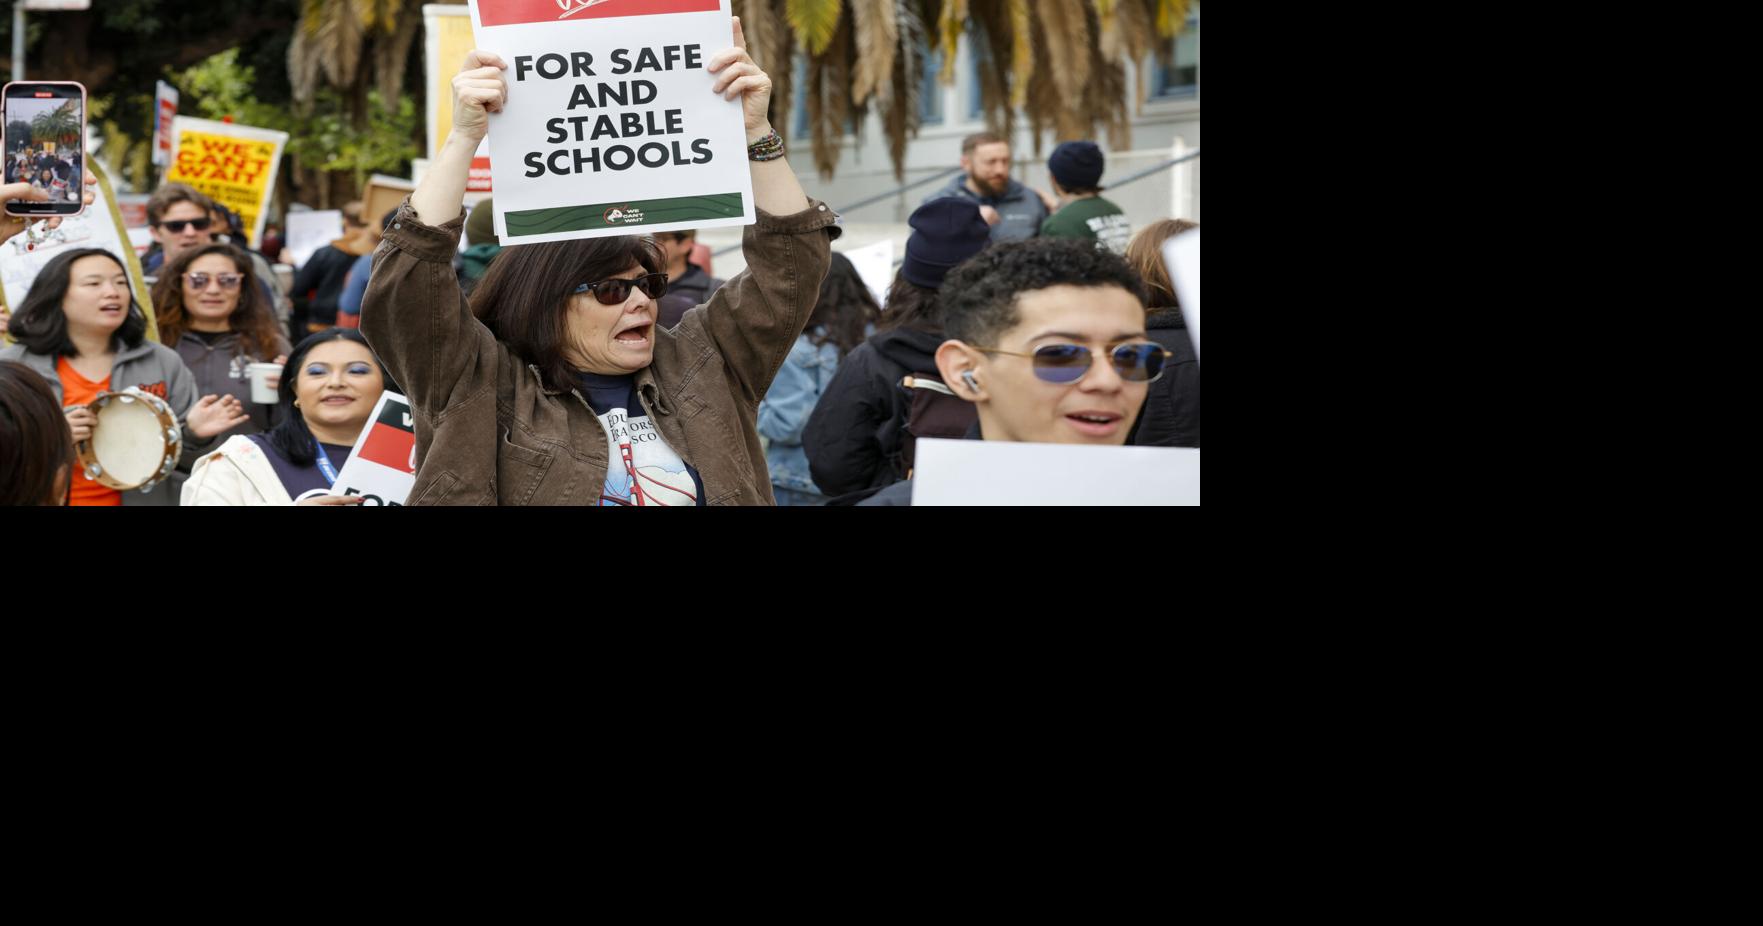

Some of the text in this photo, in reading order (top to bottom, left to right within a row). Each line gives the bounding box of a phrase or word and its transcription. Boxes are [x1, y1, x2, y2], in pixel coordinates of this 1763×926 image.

[514, 43, 703, 82] FOR SAFE
[566, 79, 658, 111] AND
[546, 108, 684, 144] STABLE
[202, 139, 249, 156] WE
[523, 138, 713, 178] SCHOOLS
[178, 164, 257, 185] WAIT
